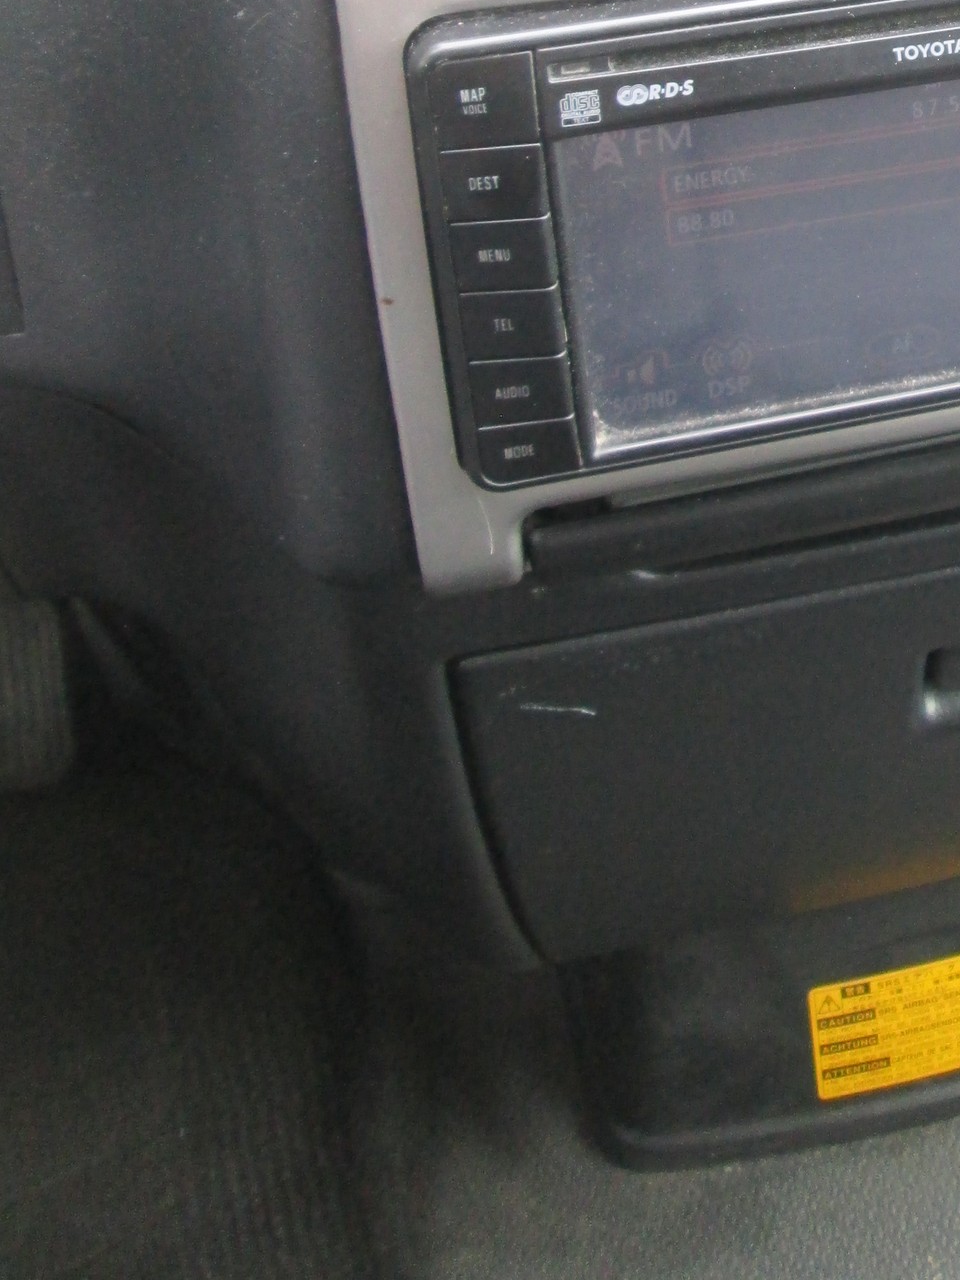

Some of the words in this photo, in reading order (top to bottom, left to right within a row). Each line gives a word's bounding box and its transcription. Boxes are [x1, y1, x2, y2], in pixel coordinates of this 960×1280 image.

[460, 87, 485, 103] MAP
[463, 103, 487, 115] VOICE
[634, 121, 692, 156] FM
[468, 175, 499, 191] DEST
[477, 249, 511, 263] MENU
[494, 318, 514, 333] TEL
[495, 385, 530, 399] AUDIO
[504, 445, 534, 460] MODE
[820, 1011, 874, 1030] CAUTION
[822, 1036, 877, 1055] ACHTUNG
[824, 1060, 888, 1080] ATTENTION
